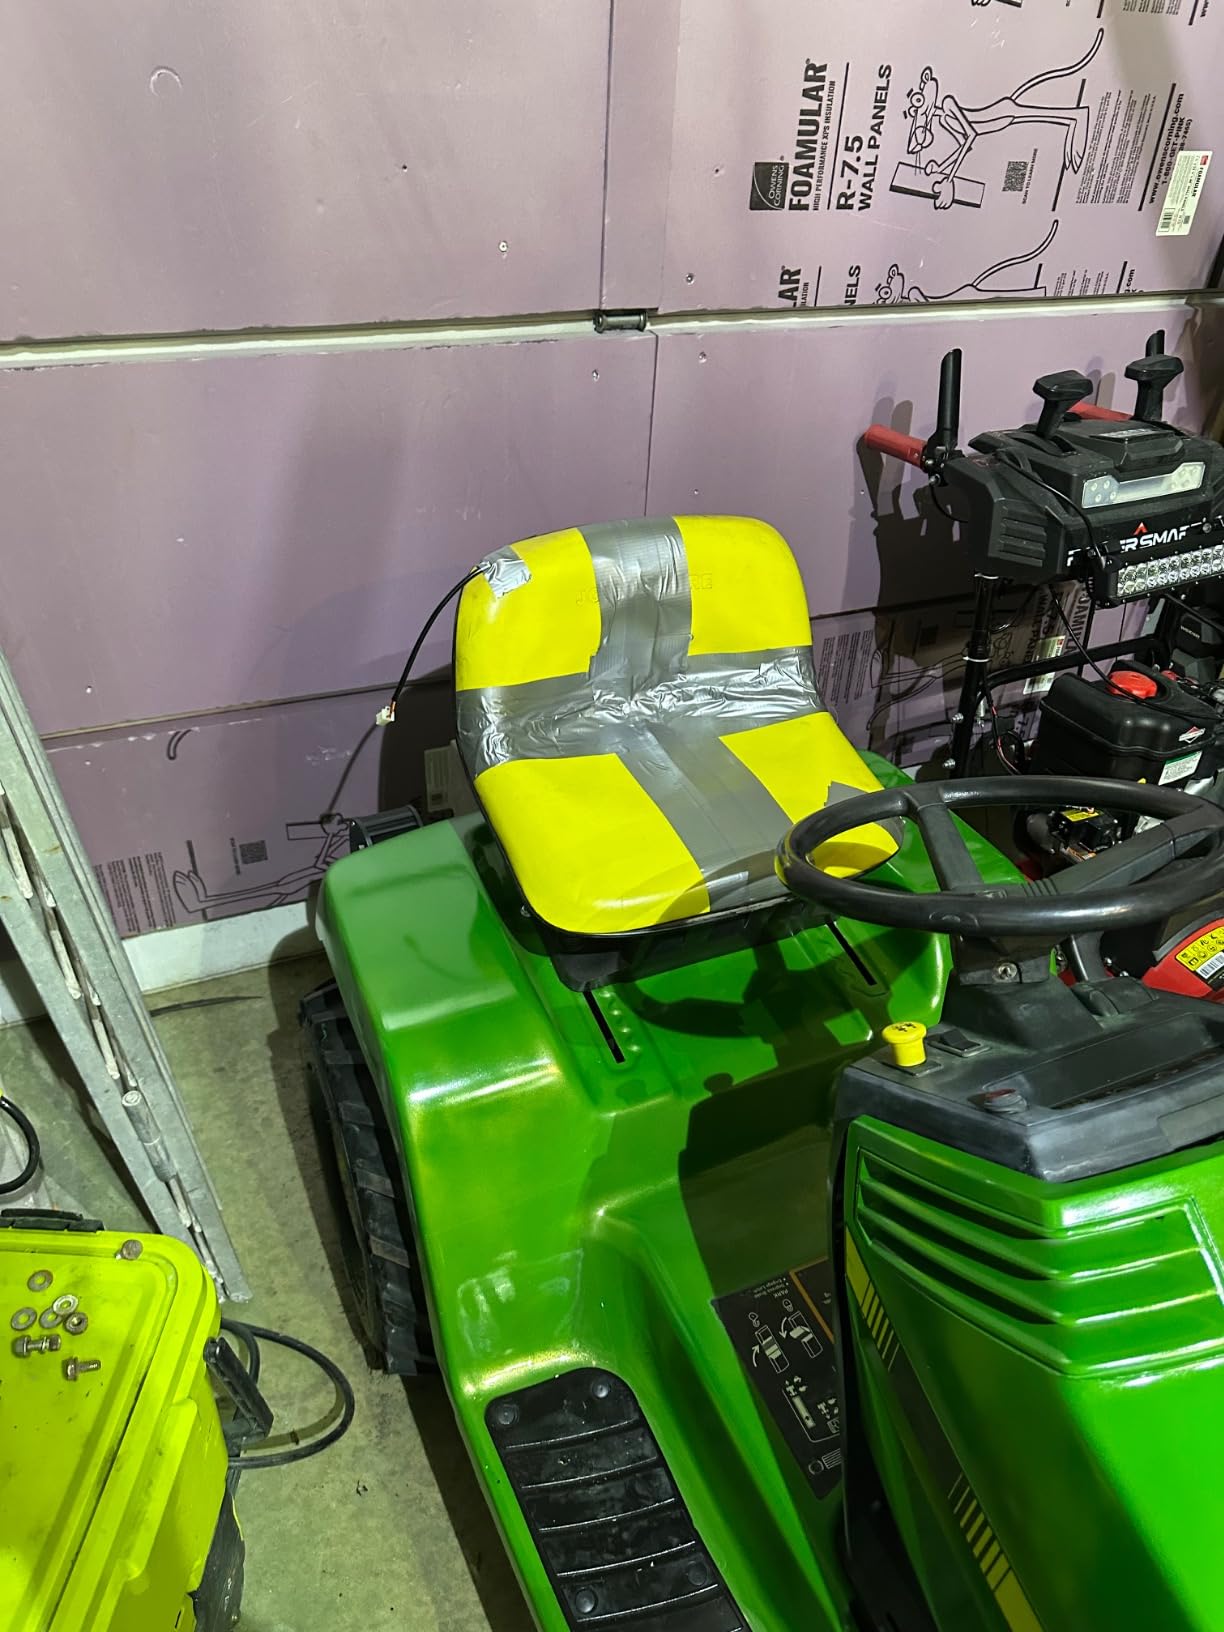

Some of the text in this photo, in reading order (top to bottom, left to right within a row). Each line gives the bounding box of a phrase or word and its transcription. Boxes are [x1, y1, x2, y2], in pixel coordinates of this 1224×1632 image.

[768, 165, 779, 199] OWENS
[788, 62, 828, 211] FOAMULAR
[812, 80, 836, 211] HIGH PERFORMANCE XPS INSULATION
[836, 135, 864, 210] R-7.5
[858, 64, 892, 211] WALL PANELS
[1149, 93, 1185, 204] www.owenscorning.com
[1161, 116, 1186, 185] 1-800-GET-PINK
[773, 165, 785, 206] CORNING
